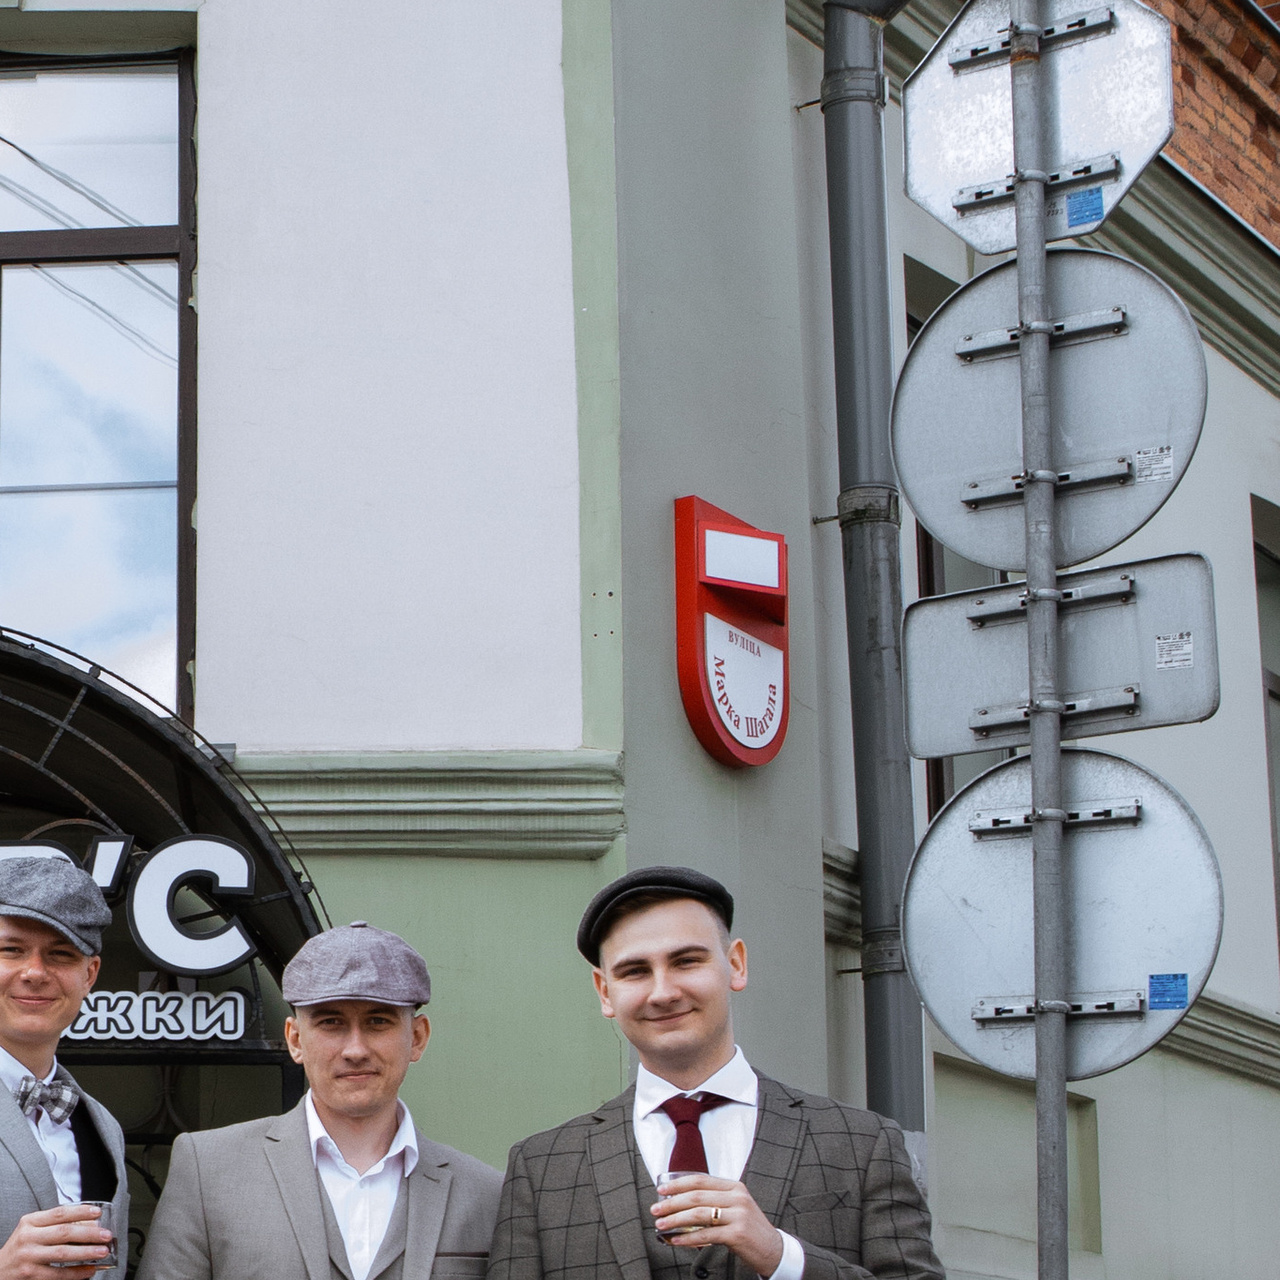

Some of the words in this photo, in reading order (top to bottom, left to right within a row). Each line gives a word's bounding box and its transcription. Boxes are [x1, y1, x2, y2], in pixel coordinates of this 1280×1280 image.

[728, 630, 762, 658] ВУЛІЦА
[714, 655, 740, 730] Марка
[745, 683, 777, 738] Шагала
